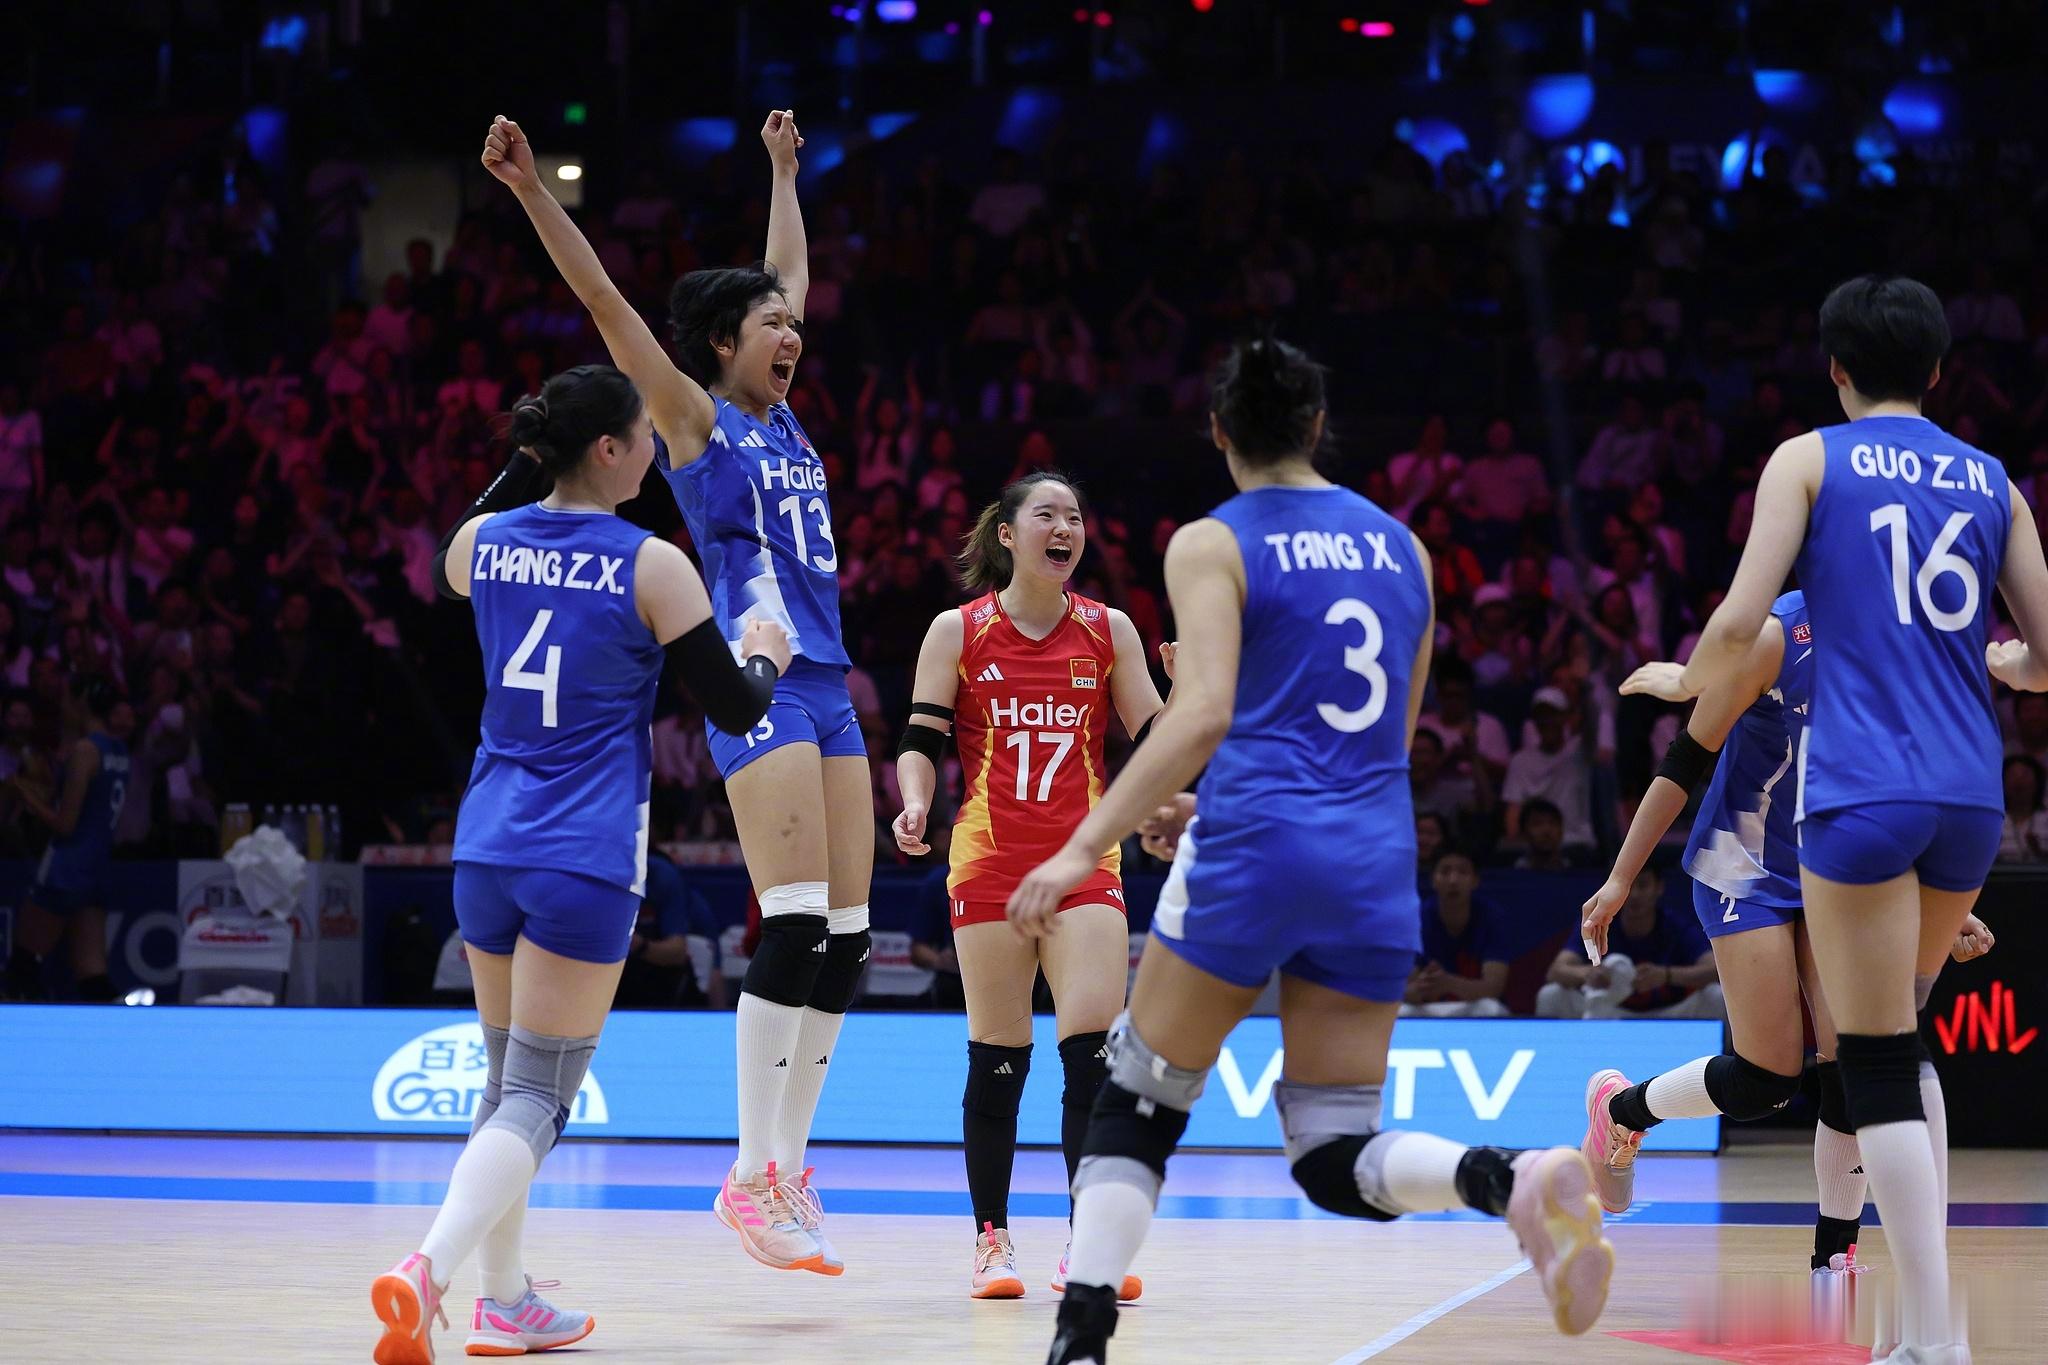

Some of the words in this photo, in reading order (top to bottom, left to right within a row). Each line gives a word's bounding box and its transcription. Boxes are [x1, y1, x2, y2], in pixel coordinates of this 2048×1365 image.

[759, 457, 828, 491] Haie
[1850, 443, 1922, 485] GUO
[1931, 453, 1994, 498] Z.N.
[778, 495, 838, 573] 13
[1263, 530, 1365, 573] TANG
[1363, 531, 1402, 574] X.
[473, 543, 563, 587] ZHANG
[563, 551, 625, 595] Z.X.
[1869, 503, 1980, 632] 16
[1793, 624, 1811, 640] 光
[501, 608, 562, 728] 4
[1075, 678, 1095, 687] CHN
[1315, 597, 1389, 734] 3
[990, 694, 1089, 727] Haier
[1006, 730, 1075, 802] 17
[1720, 893, 1740, 923] 2
[1934, 980, 2038, 1055] VNL
[1217, 1047, 1537, 1121] VTV
